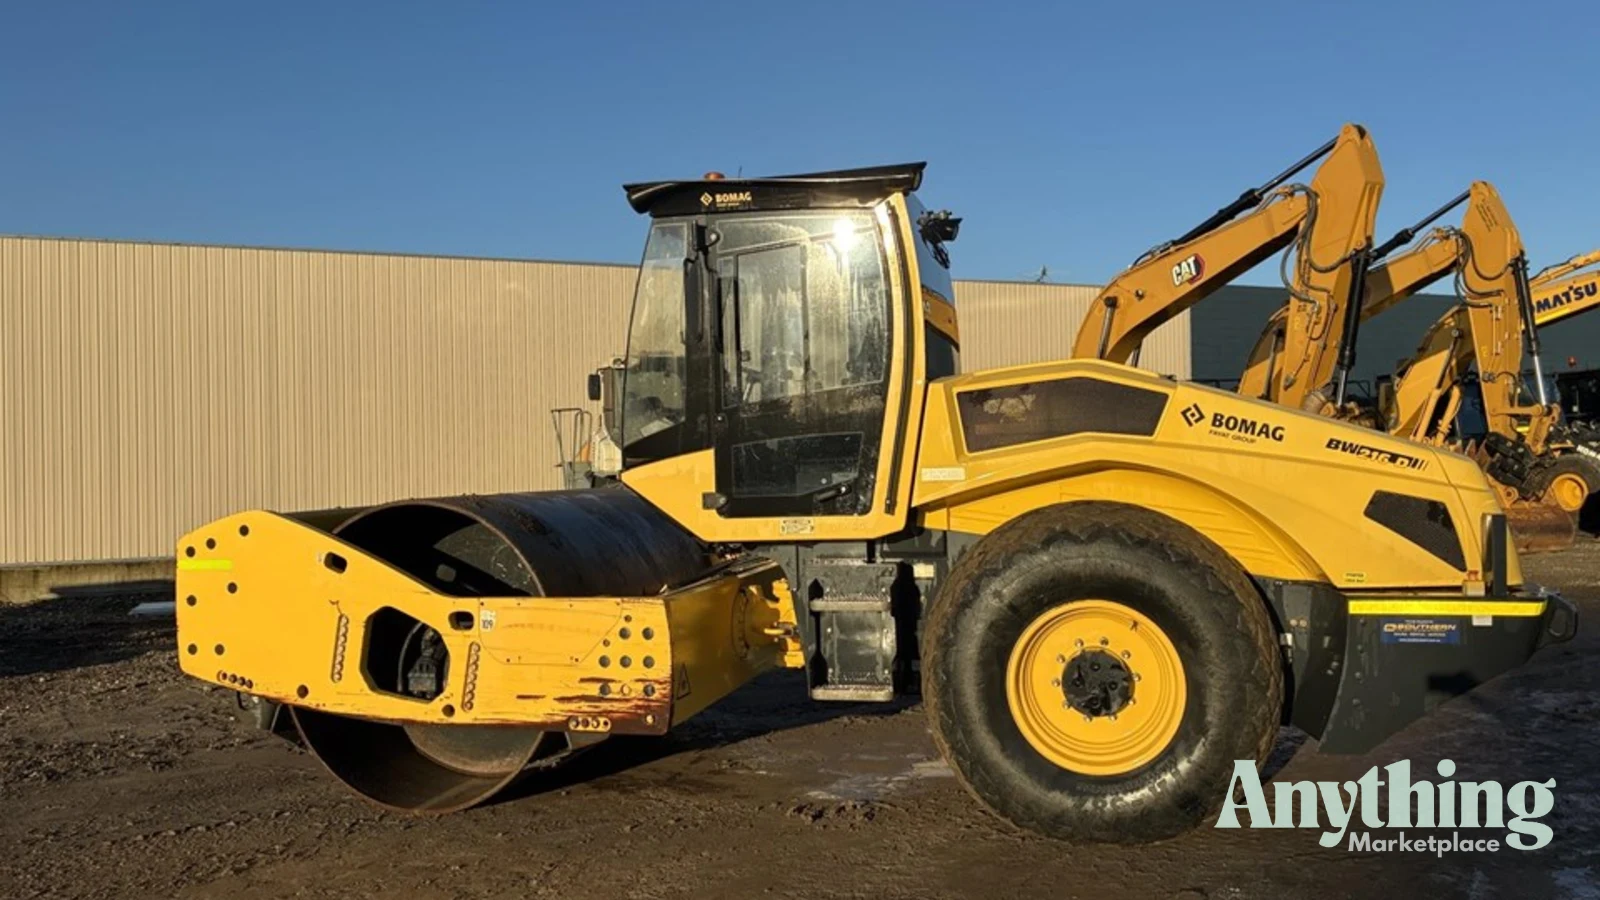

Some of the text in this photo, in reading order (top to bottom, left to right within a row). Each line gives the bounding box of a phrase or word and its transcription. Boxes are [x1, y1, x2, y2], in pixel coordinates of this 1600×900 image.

[715, 191, 752, 203] BOMAG
[1172, 255, 1197, 286] CAT
[1533, 282, 1598, 314] MATSU
[1211, 412, 1285, 442] BOMAG
